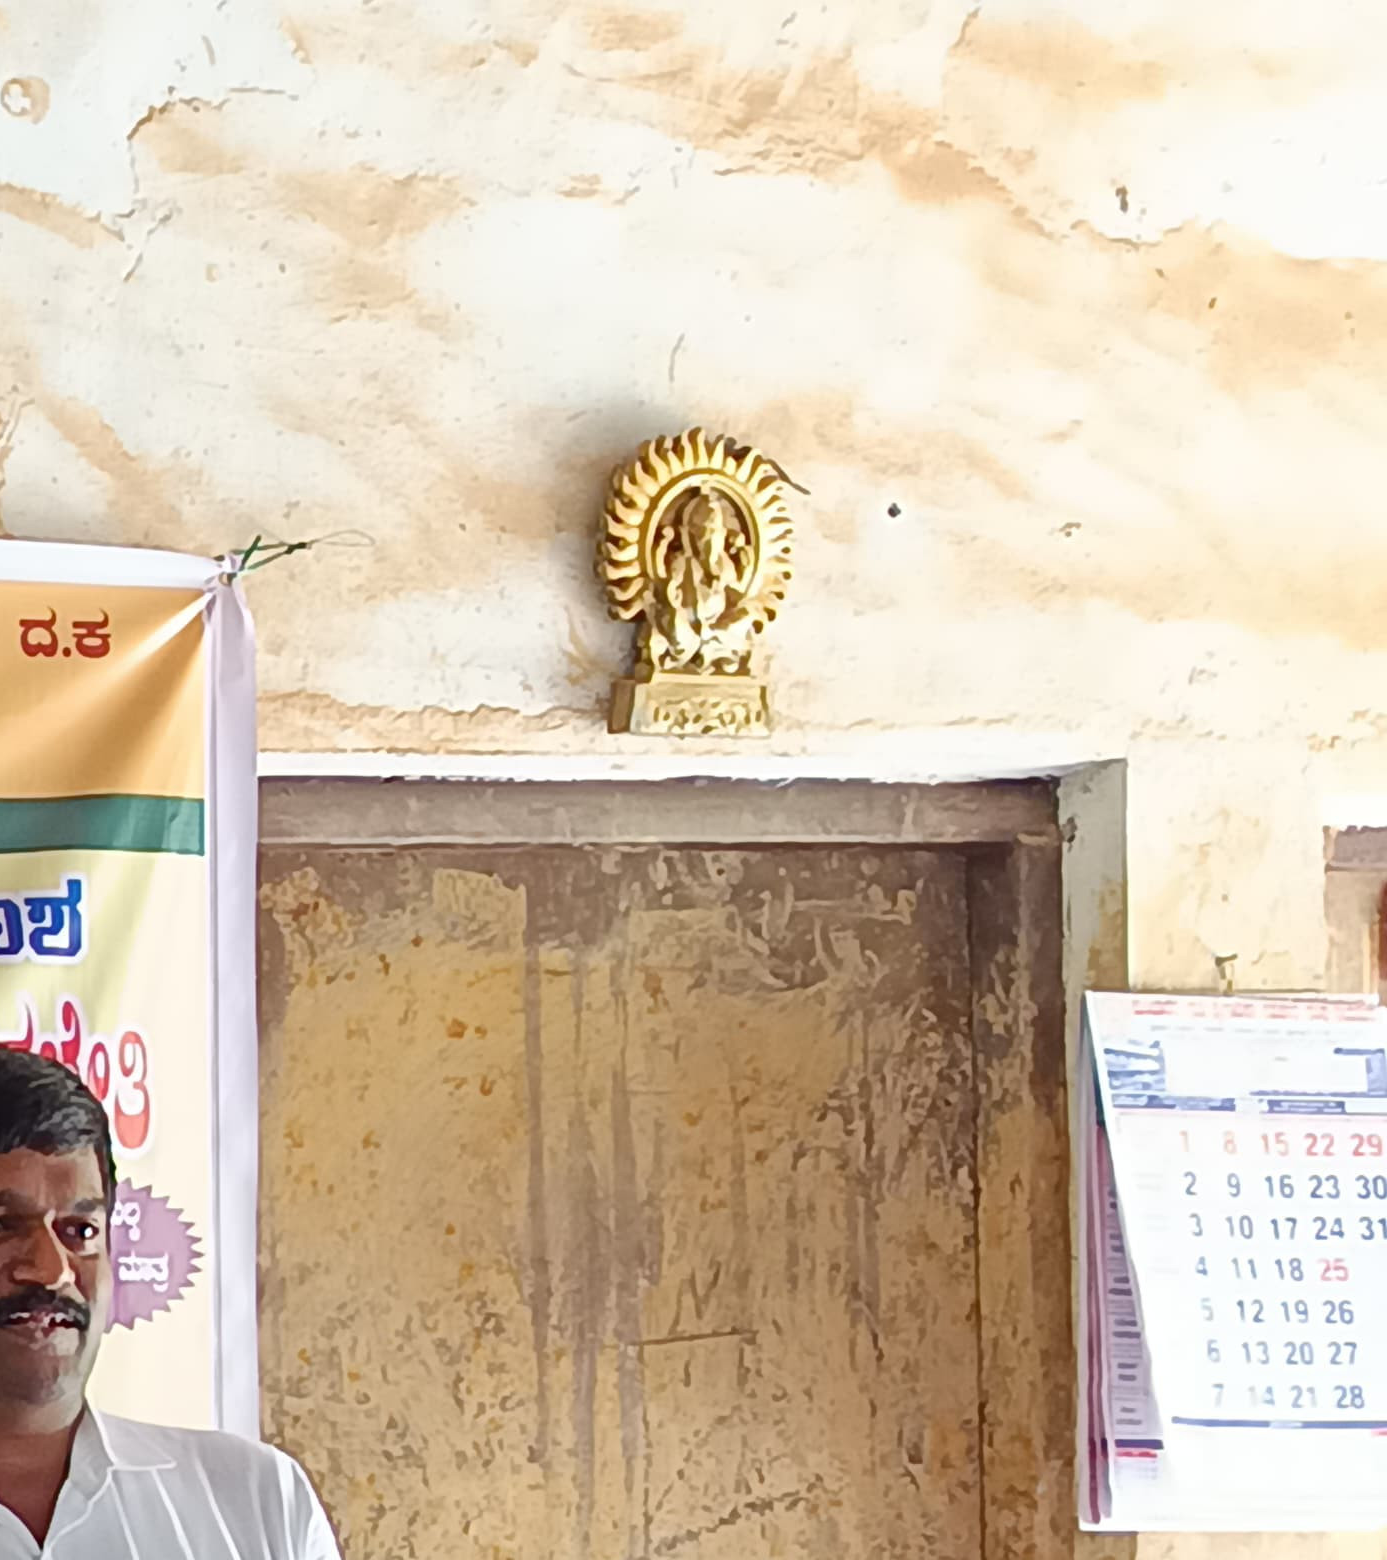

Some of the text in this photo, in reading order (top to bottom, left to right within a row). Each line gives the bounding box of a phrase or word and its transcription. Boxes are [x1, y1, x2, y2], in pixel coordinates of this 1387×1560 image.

[20, 607, 111, 658] ದ.ಕ
[1261, 1132, 1289, 1157] 15
[1304, 1133, 1335, 1157] 22
[1350, 1133, 1383, 1157] 29
[1184, 1171, 1387, 1200] 2 9 16 23 30
[1189, 1213, 1387, 1241] 3 10 17 24 31
[1195, 1256, 1349, 1282] 4 11 18 25
[1201, 1297, 1354, 1325] 5 12 19 26
[1207, 1339, 1357, 1365] 6 13 20 27
[1290, 1385, 1317, 1409] 21
[1334, 1385, 1365, 1409] 28
